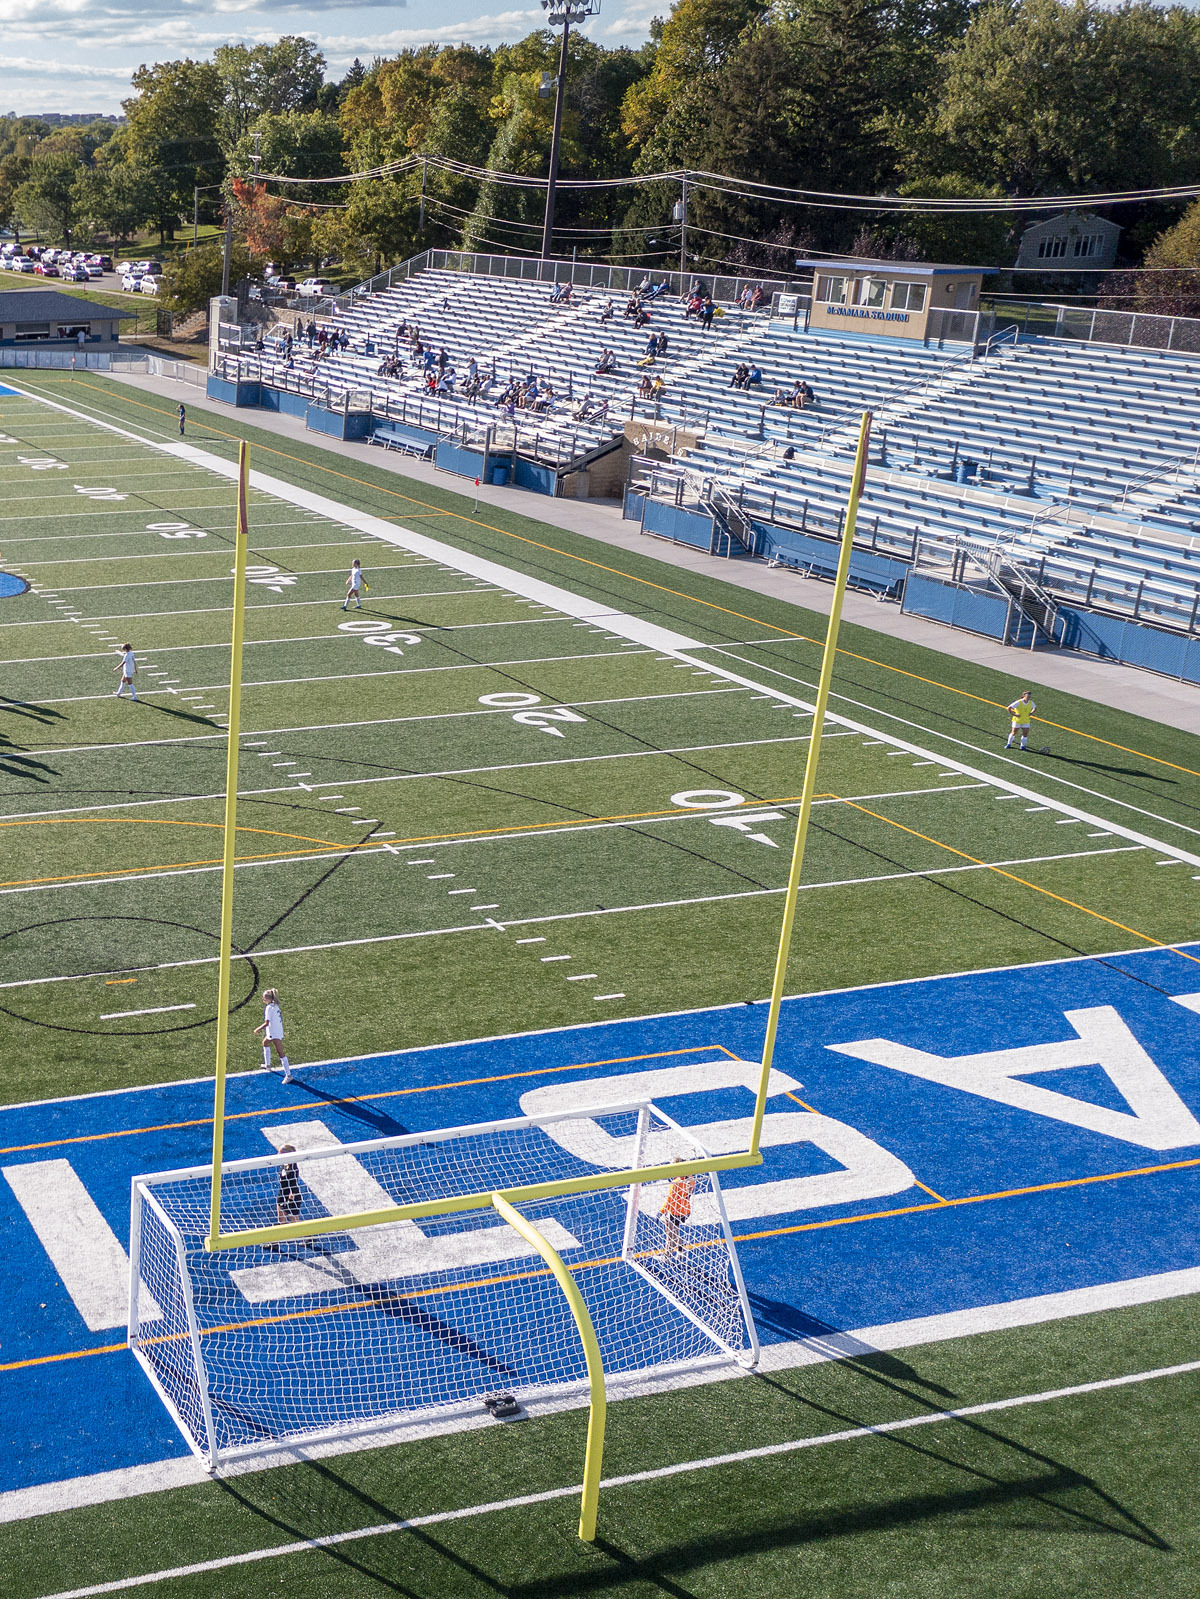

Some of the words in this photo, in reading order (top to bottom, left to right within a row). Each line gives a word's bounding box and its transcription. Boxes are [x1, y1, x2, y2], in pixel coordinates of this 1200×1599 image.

[827, 306, 870, 319] McNAMARA
[871, 310, 911, 323] STADIUM
[633, 431, 684, 457] RAIDES
[20, 458, 69, 470] 30
[76, 487, 129, 500] 40
[145, 522, 208, 539] 50
[230, 565, 298, 586] 40
[337, 620, 422, 648] 30
[478, 692, 588, 726] 20
[670, 789, 787, 832] 10
